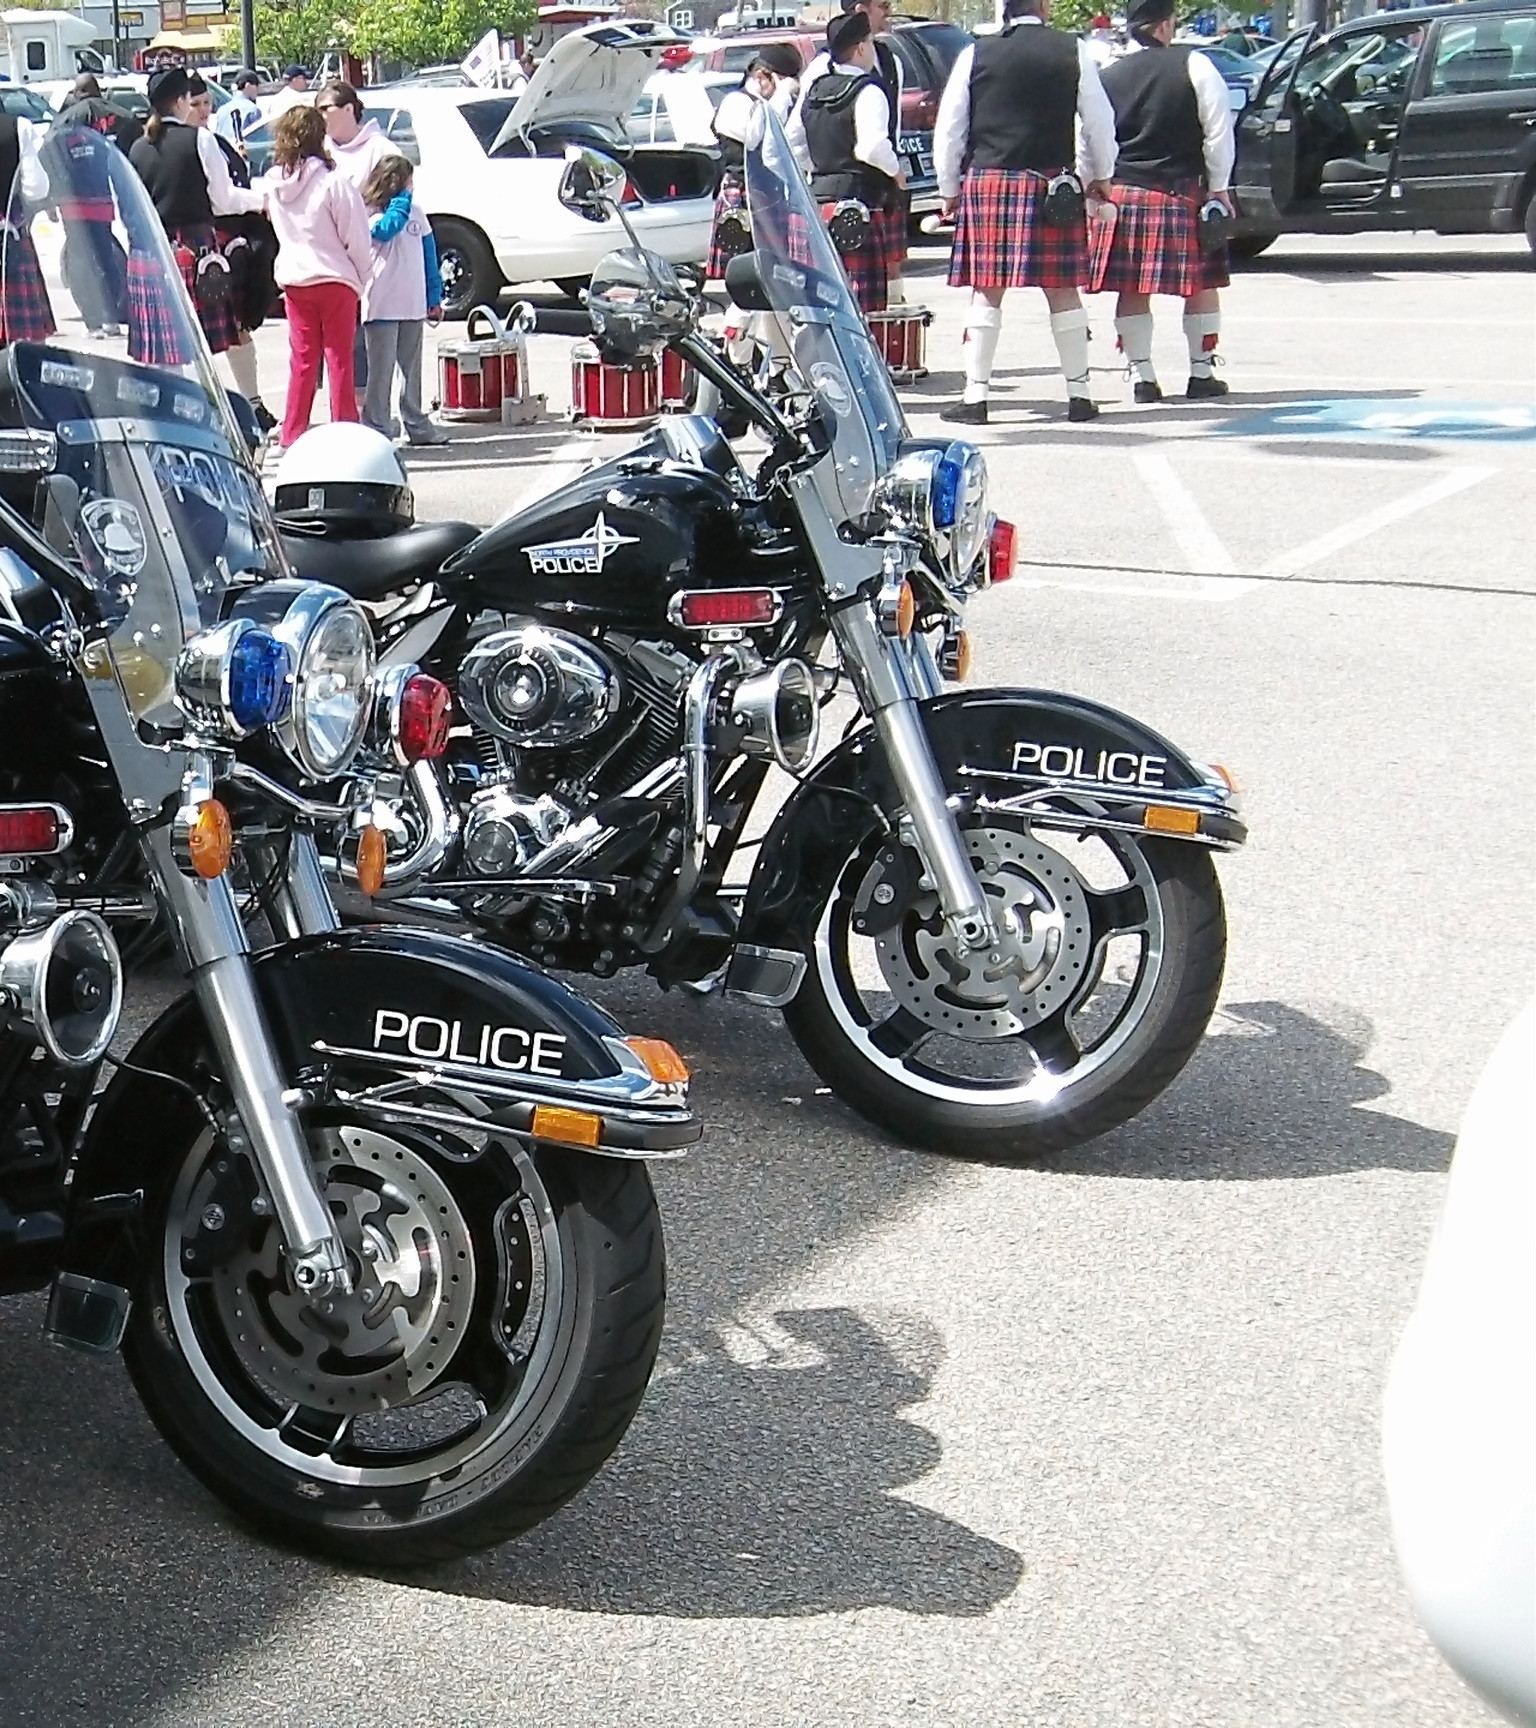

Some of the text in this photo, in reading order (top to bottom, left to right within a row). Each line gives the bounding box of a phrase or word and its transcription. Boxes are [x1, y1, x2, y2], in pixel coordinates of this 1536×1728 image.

[531, 557, 600, 574] POLICE
[1012, 741, 1167, 788] POLICE
[373, 1009, 566, 1076] POLICE
